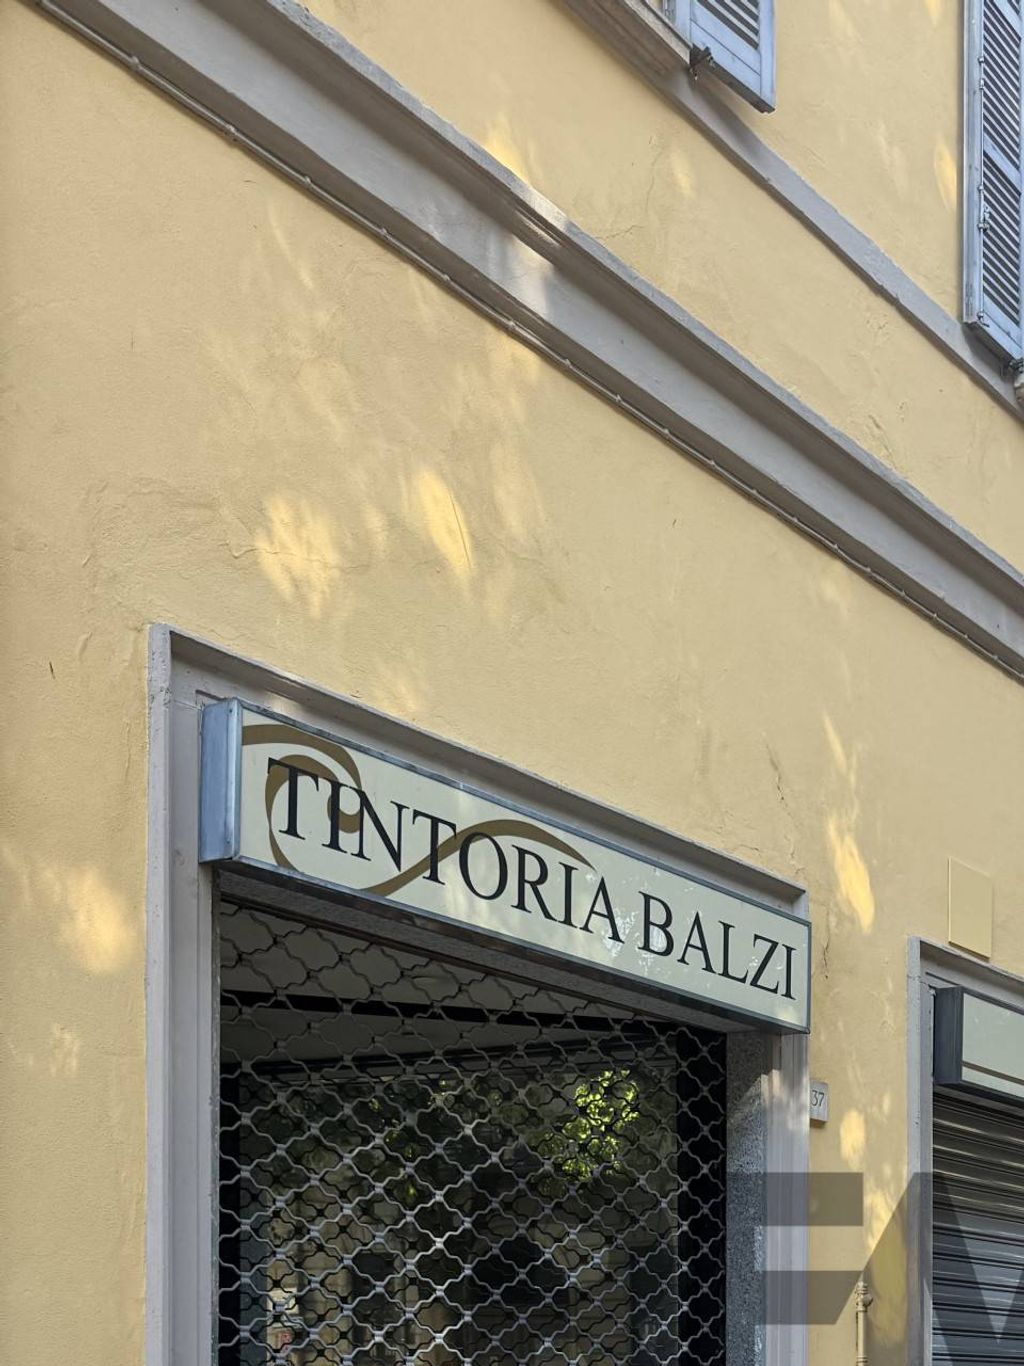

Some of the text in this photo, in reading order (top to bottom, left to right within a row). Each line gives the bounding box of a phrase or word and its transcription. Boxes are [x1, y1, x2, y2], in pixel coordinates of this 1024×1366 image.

[267, 756, 797, 1001] TINTORIA BALZI
[810, 1089, 825, 1107] 37
